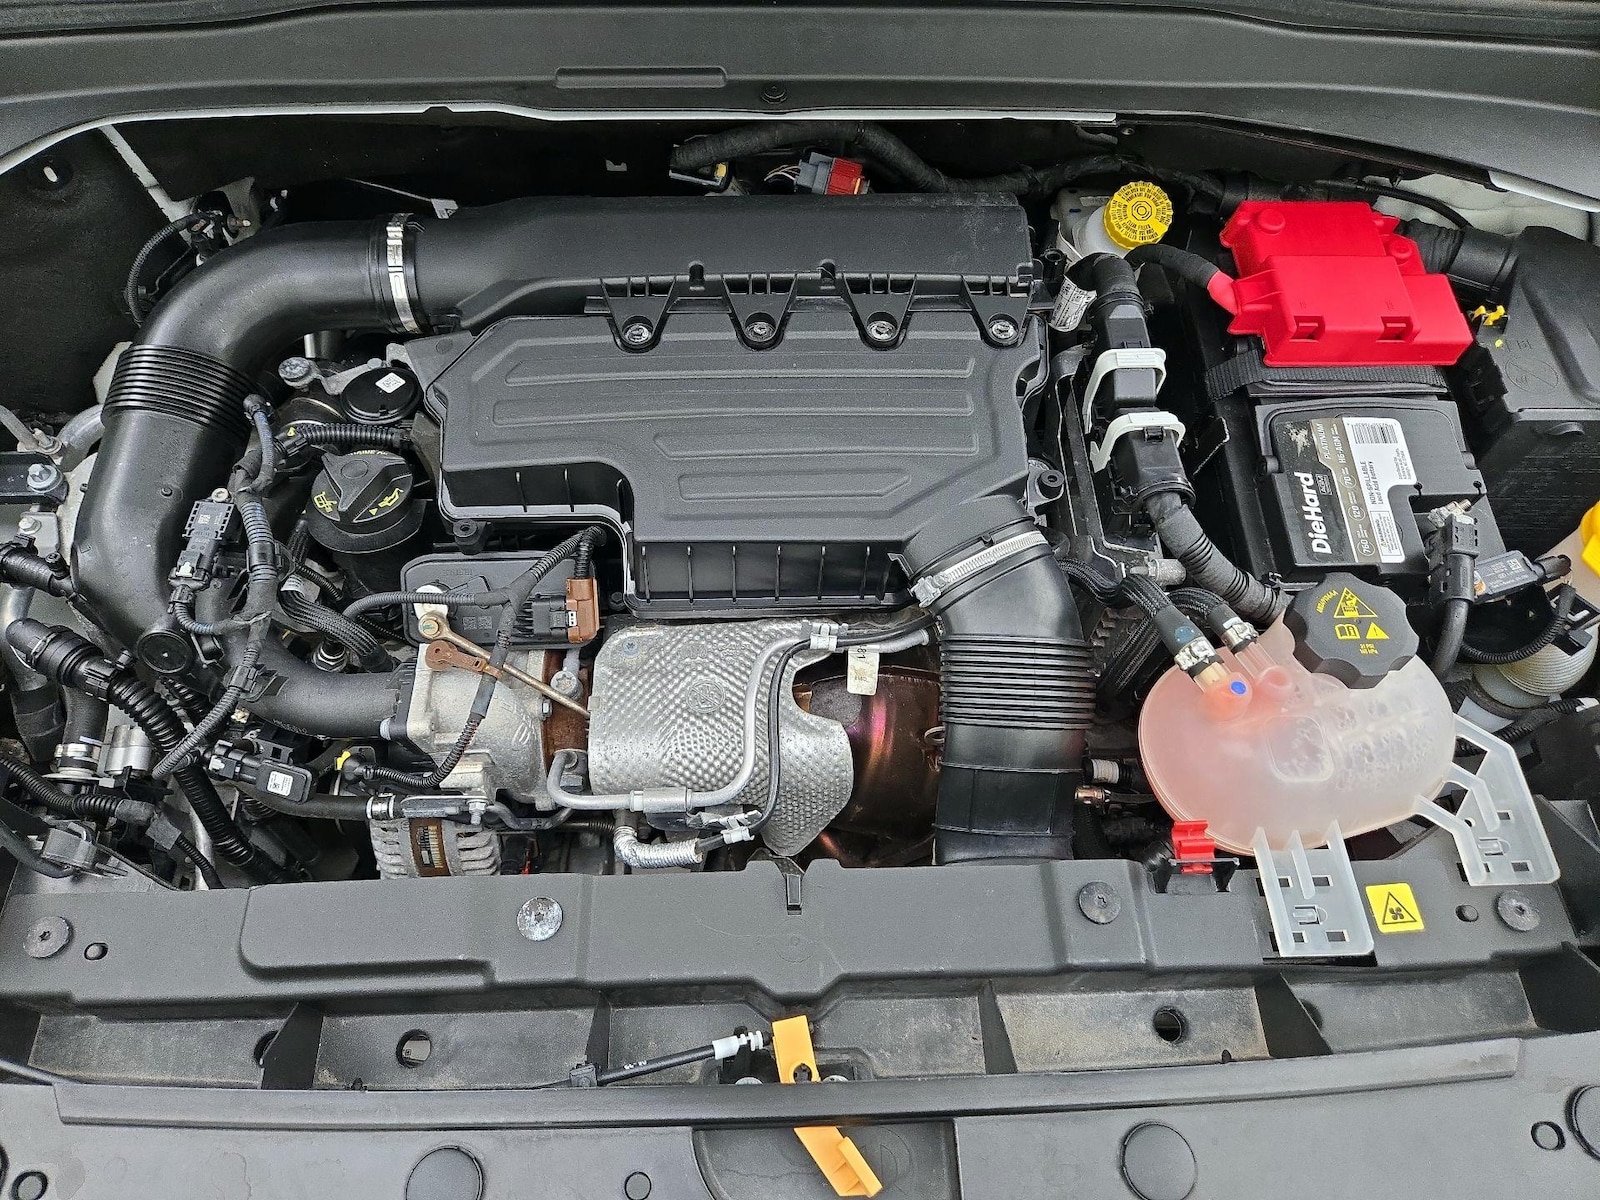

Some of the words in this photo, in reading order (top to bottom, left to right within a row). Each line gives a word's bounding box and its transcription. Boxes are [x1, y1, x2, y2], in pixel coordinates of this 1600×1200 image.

[1317, 423, 1331, 459] PLATINUM
[1344, 476, 1353, 486] 70
[1360, 461, 1377, 504] NON-SPILLABLE
[1294, 471, 1333, 554] DieHard
[1351, 505, 1361, 519] 120
[1361, 540, 1371, 554] 760
